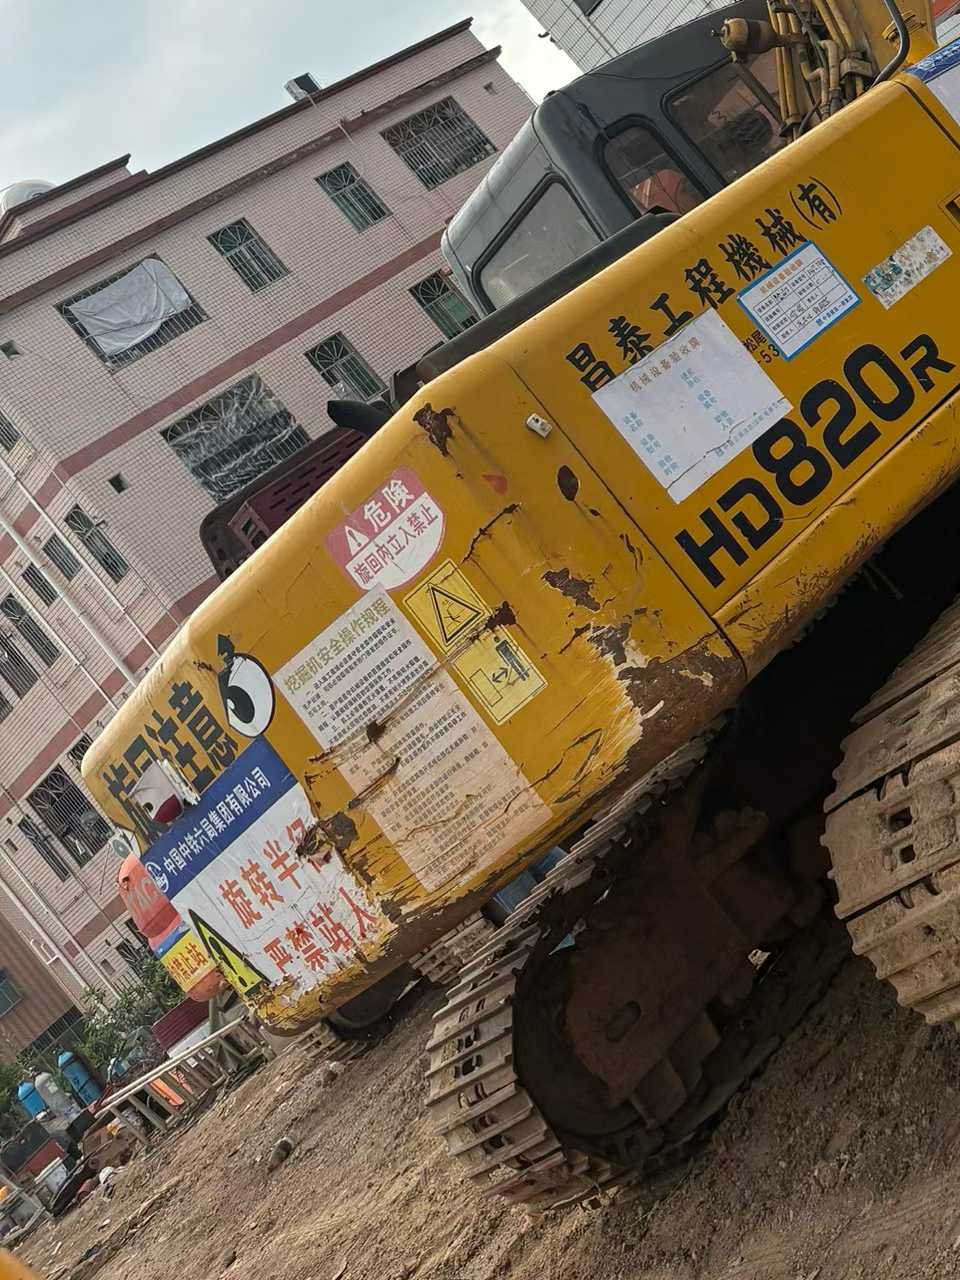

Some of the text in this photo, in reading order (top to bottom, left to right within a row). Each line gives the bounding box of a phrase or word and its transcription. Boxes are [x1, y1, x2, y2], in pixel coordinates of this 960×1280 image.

[674, 333, 956, 588] HD820R
[352, 501, 440, 585] 旋回内立入禁止
[282, 597, 392, 694] 挖掘机安全操作规程
[161, 765, 273, 876] 中国中铁六局集团有限公司
[262, 887, 379, 976] 严禁站人
